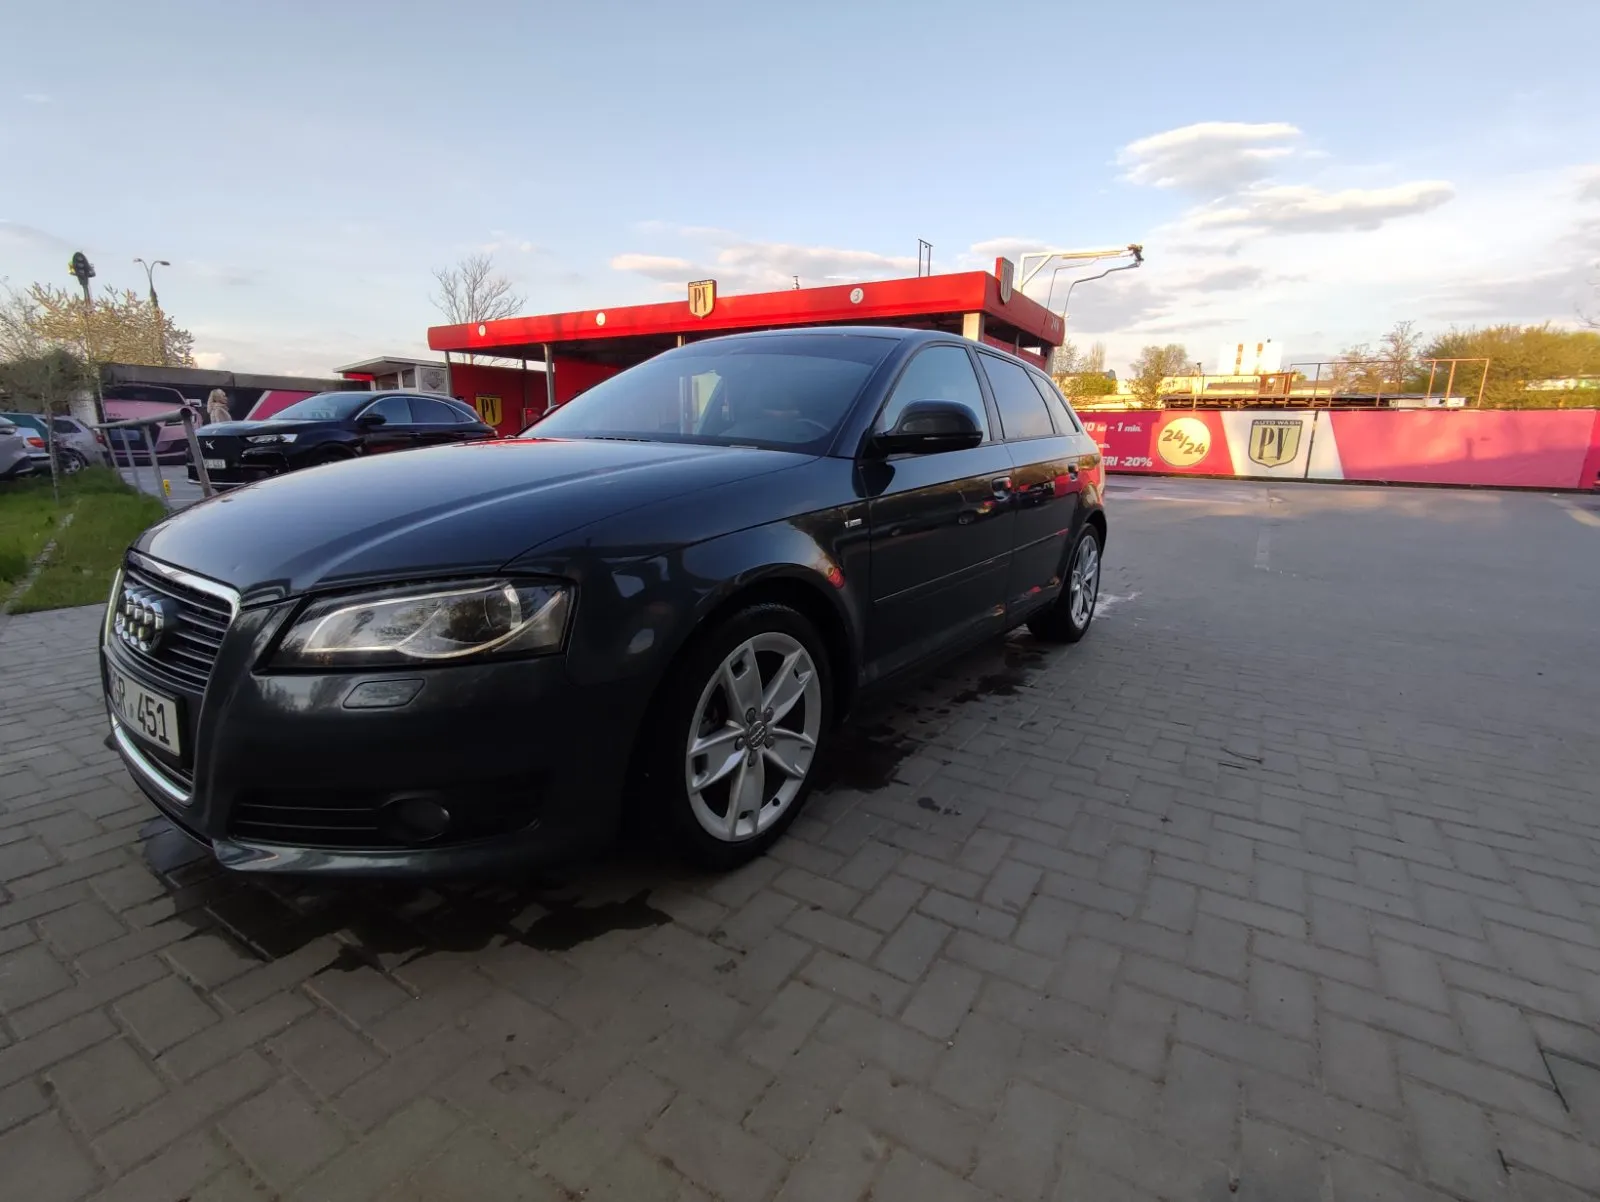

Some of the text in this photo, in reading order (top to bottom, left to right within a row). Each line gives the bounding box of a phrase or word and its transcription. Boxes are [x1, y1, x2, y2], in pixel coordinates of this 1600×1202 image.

[480, 399, 497, 423] PV
[1117, 422, 1124, 432] 1
[1257, 426, 1292, 461] PV
[1120, 456, 1153, 467] -20%
[137, 692, 170, 746] 451
